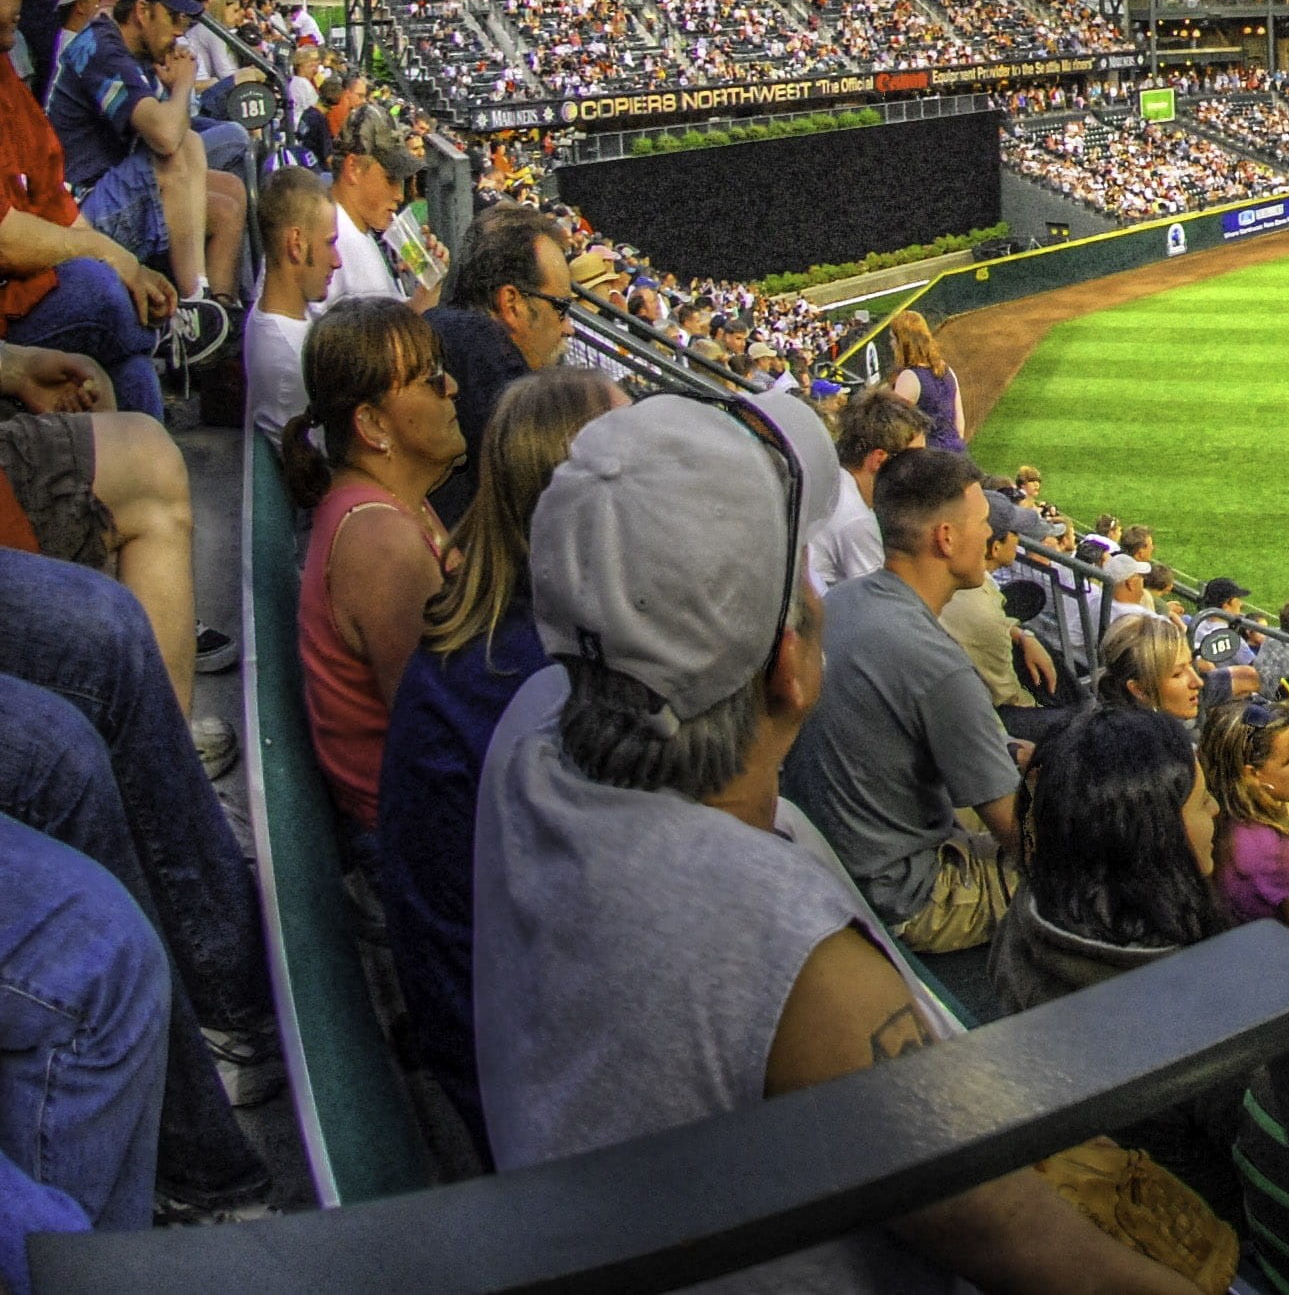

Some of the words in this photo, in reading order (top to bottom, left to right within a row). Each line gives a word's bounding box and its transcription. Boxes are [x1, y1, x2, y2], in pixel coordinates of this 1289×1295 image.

[682, 81, 812, 110] NORTHWEST
[932, 67, 976, 85] Equipment
[977, 64, 1011, 80] Provider
[241, 99, 266, 118] 181
[1211, 638, 1231, 655] 181
